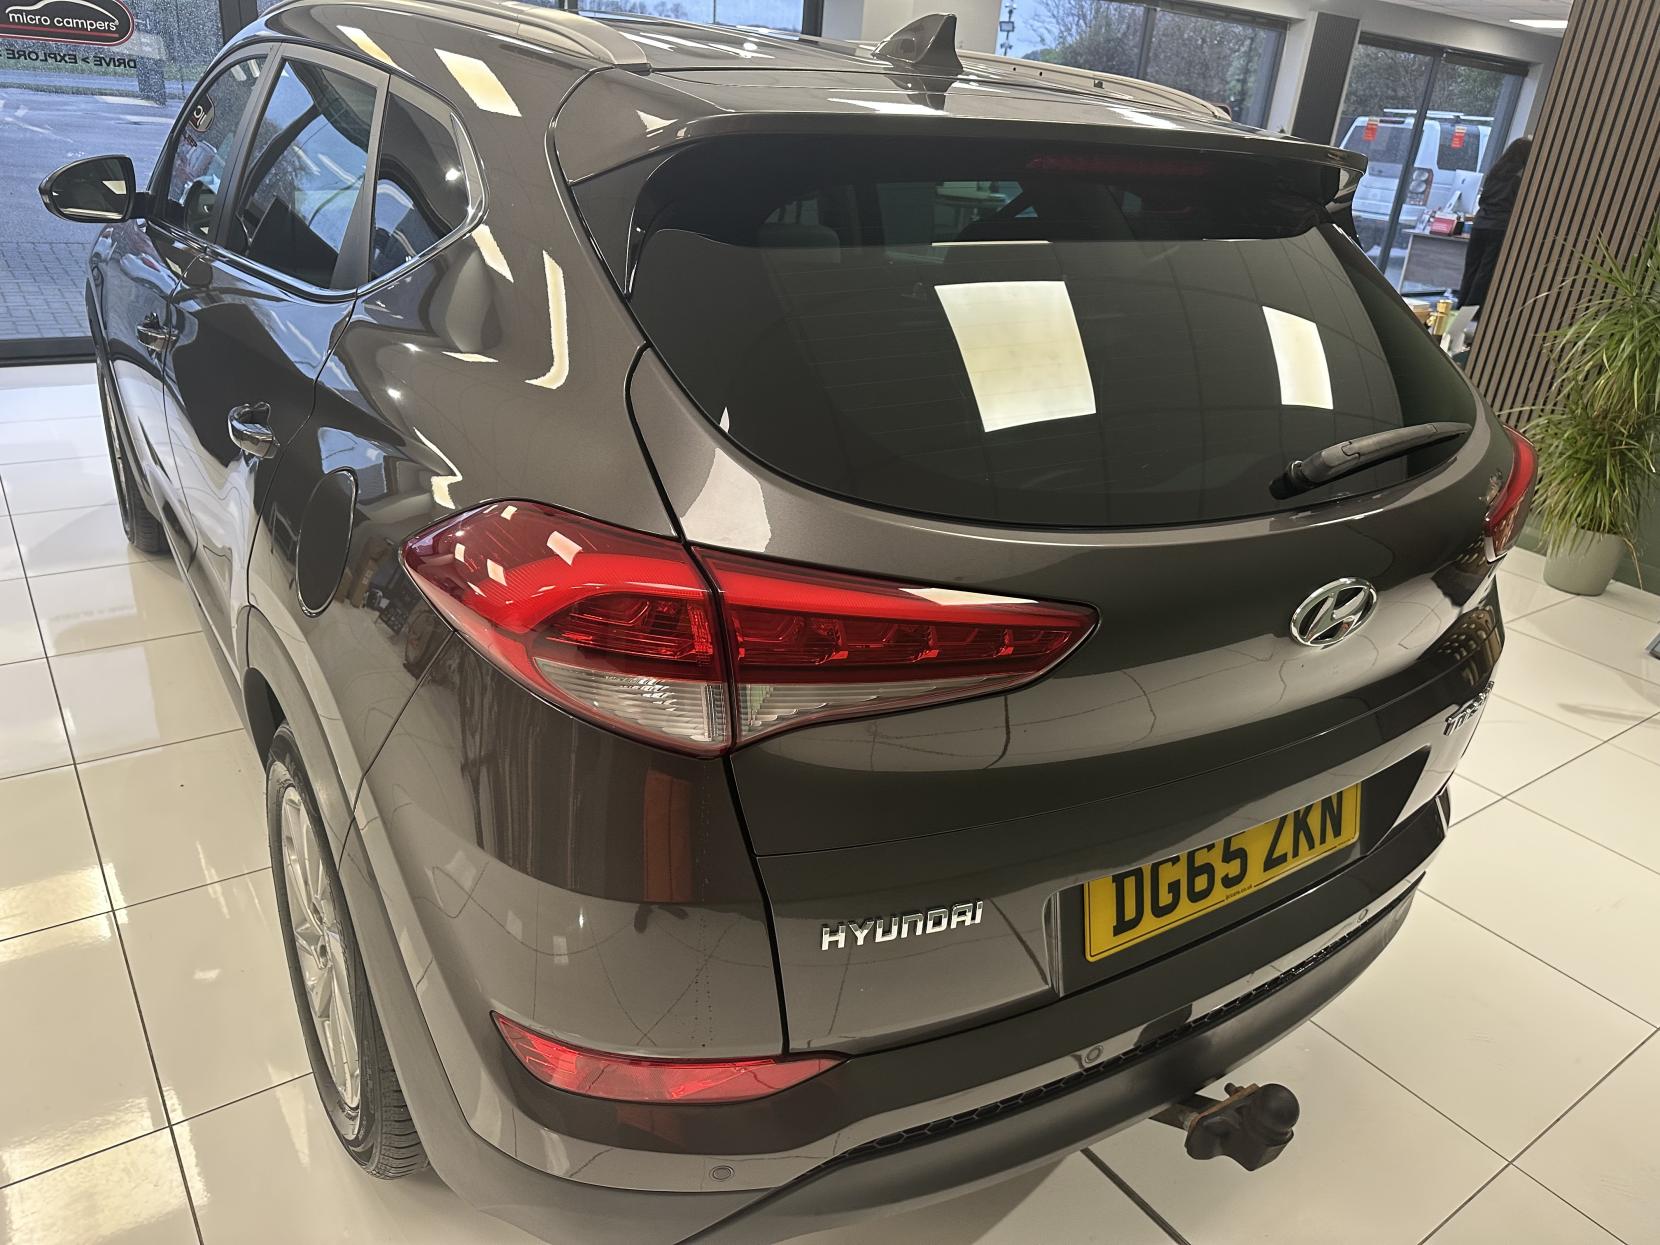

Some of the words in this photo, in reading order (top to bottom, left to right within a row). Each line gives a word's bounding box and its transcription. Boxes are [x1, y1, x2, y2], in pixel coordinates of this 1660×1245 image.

[9, 12, 50, 25] micro
[54, 16, 117, 32] campers
[1111, 831, 1248, 937] DG65
[1263, 790, 1344, 873] ZKN
[821, 901, 984, 951] HYUNDAI
